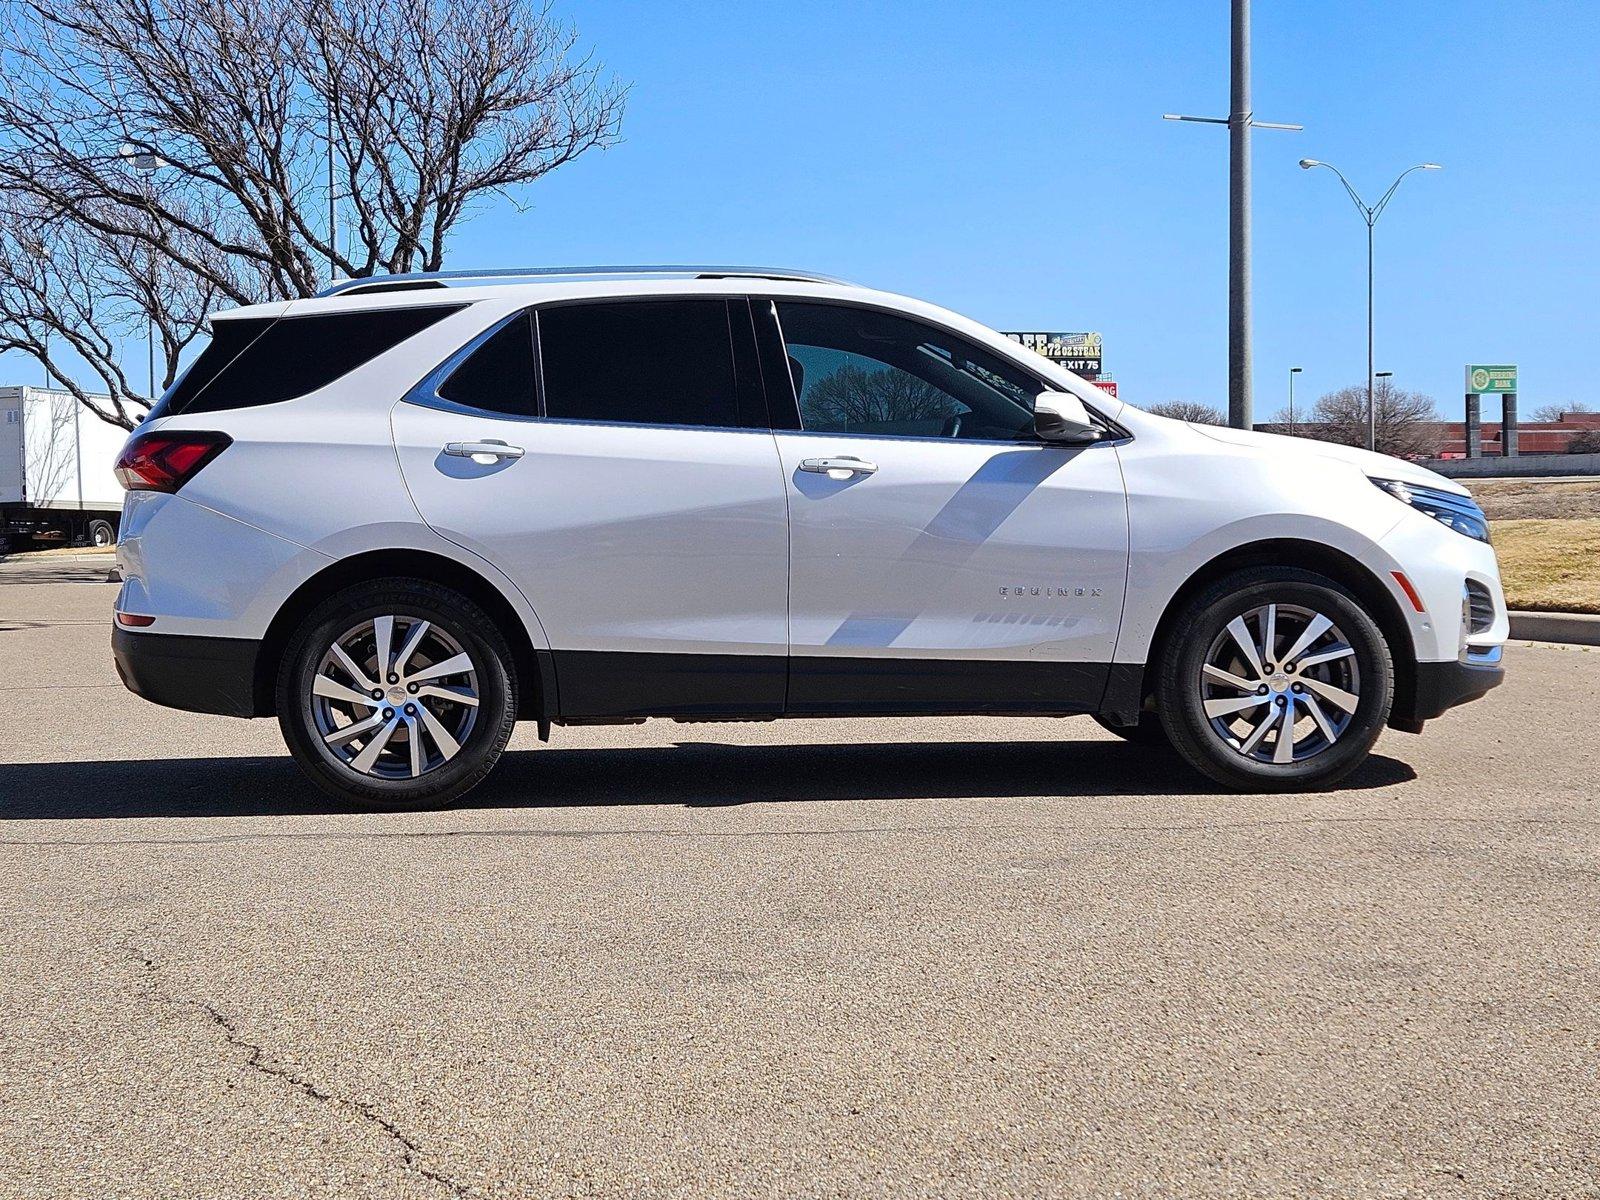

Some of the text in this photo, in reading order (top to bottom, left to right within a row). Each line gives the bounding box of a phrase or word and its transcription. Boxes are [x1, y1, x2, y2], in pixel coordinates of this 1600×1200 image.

[1047, 343, 1061, 356] 72
[1073, 346, 1100, 356] STEAK
[1060, 360, 1099, 370] EXIT 75
[998, 586, 1103, 597] EQUINOX
